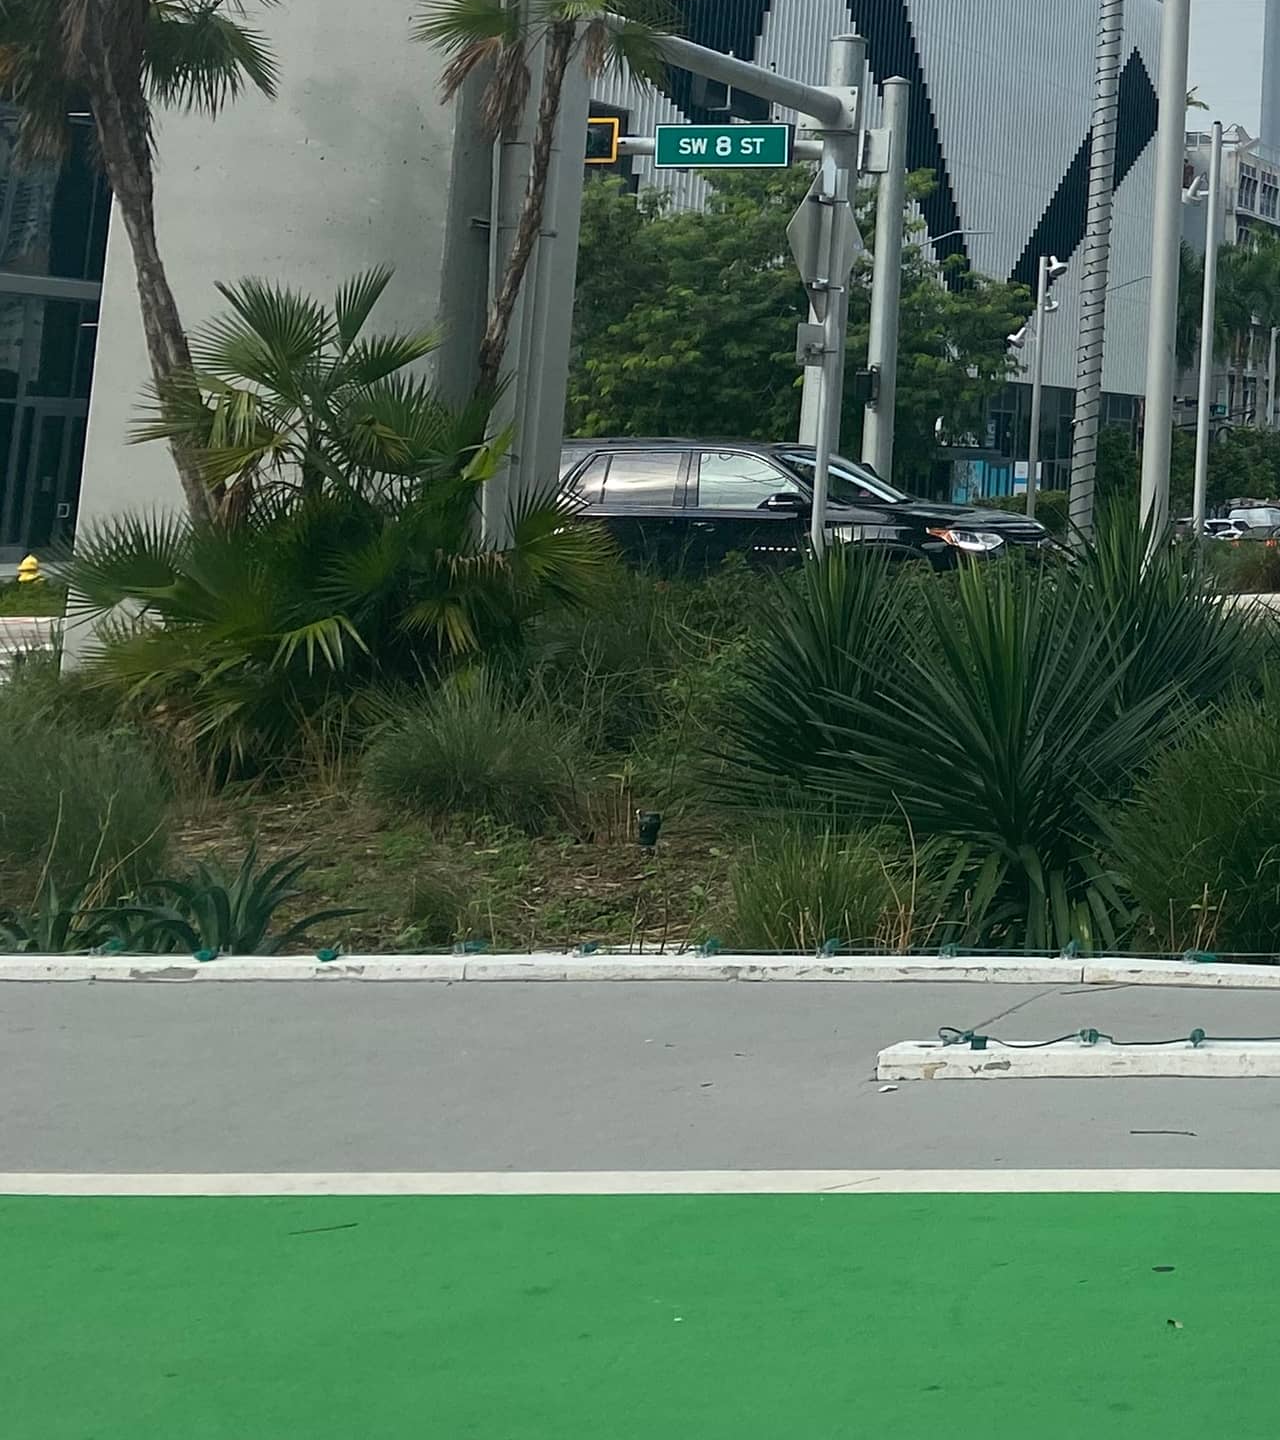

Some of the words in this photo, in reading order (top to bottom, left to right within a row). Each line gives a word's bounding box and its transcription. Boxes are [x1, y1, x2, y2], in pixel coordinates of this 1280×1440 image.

[678, 137, 708, 155] SW
[716, 135, 732, 157] 8
[740, 137, 765, 155] ST
